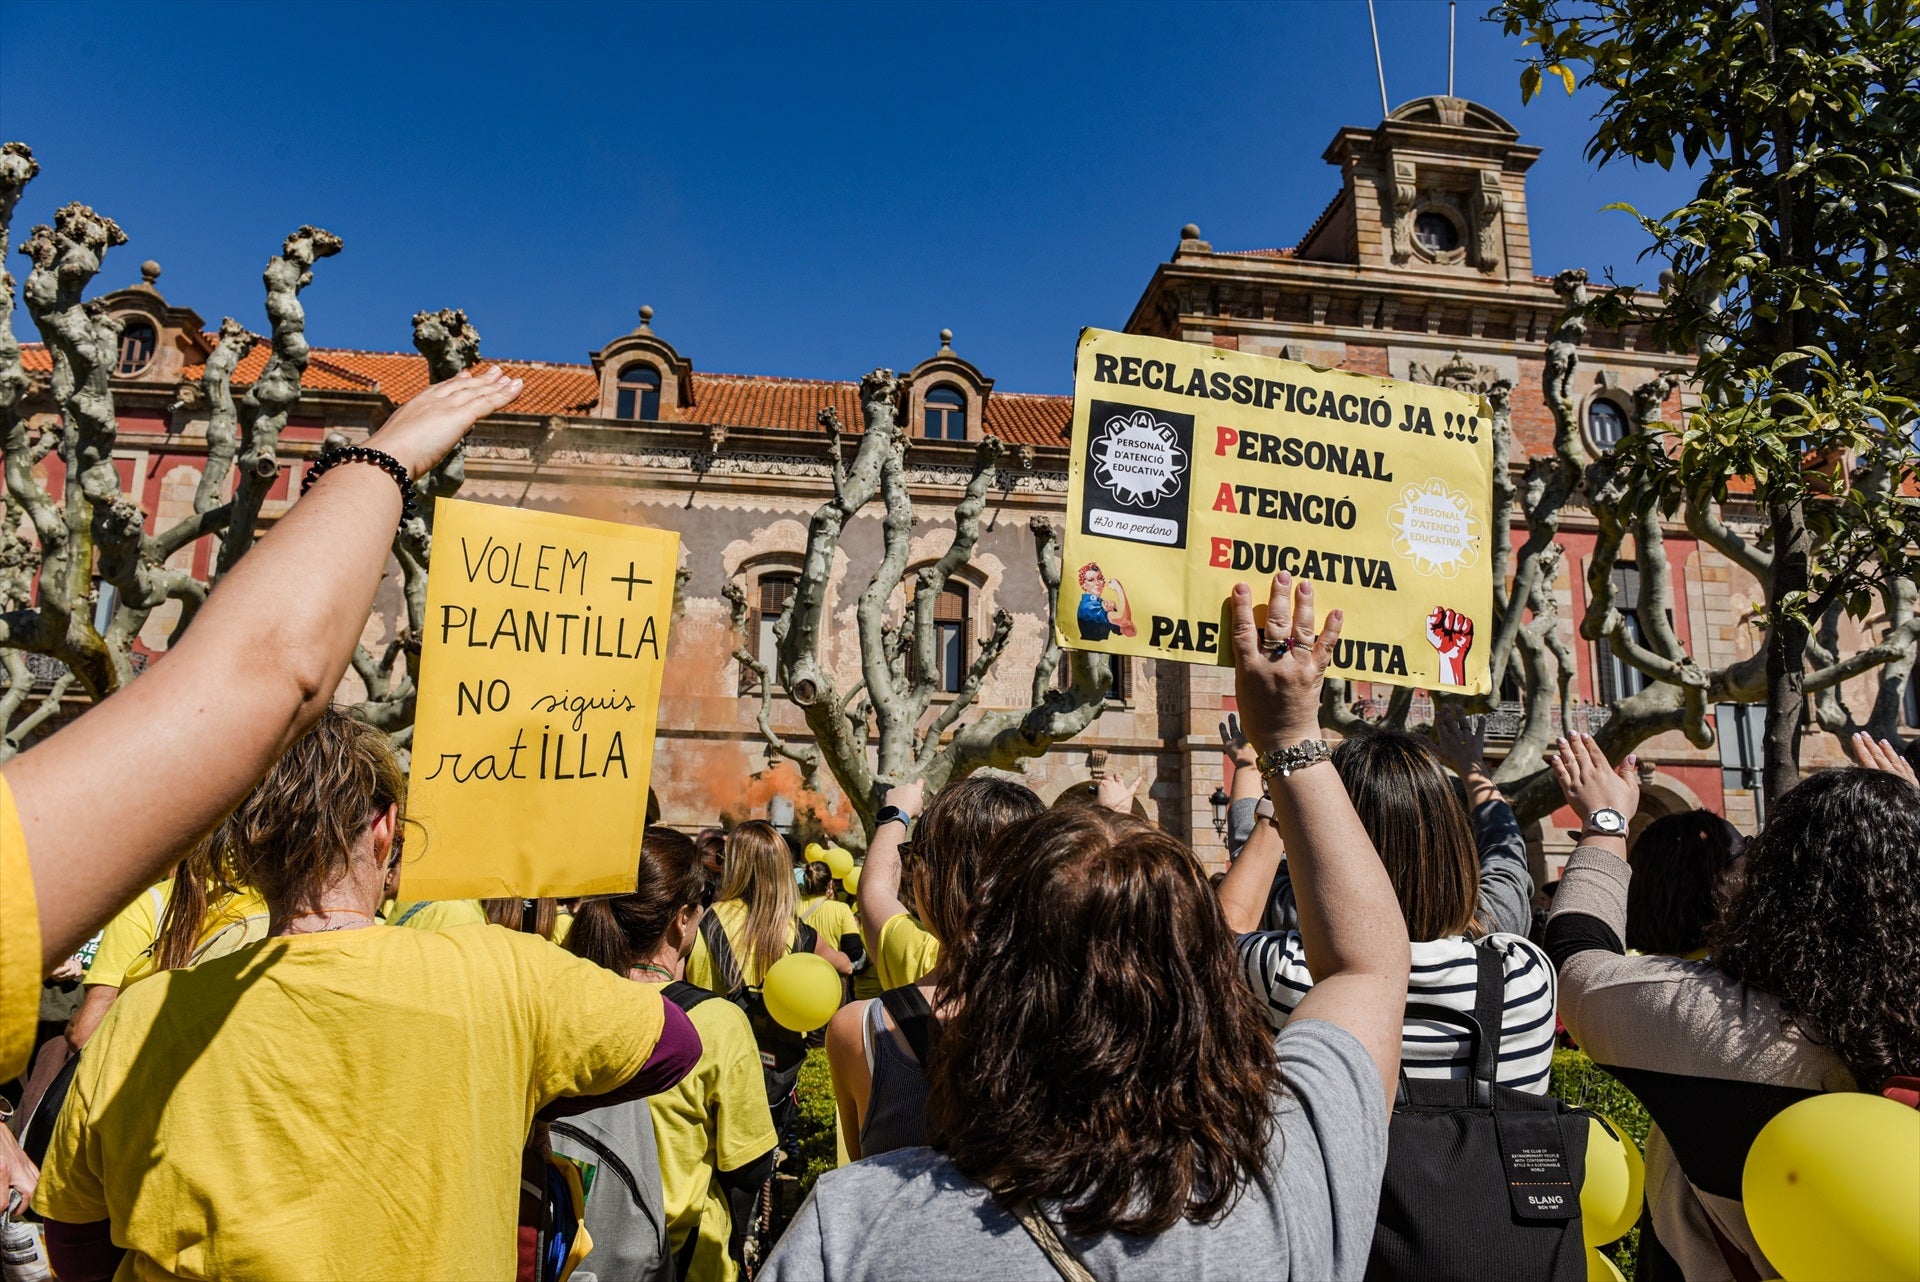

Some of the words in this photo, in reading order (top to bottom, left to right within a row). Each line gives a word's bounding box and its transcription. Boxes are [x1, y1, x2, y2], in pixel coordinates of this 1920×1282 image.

[1094, 353, 1391, 428] RECLASSIFICACIÓ
[1399, 404, 1436, 436] JA
[1117, 438, 1166, 452] PERSONAL
[1115, 450, 1164, 465] D'ATENCIÓ
[1215, 426, 1393, 482] PERSONAL
[1112, 463, 1166, 477] EDUCATIVA
[1212, 482, 1357, 529] ATENCIÓ
[1412, 506, 1460, 521] PERSONAL
[1115, 520, 1129, 530] no
[1129, 523, 1172, 537] perdono
[1411, 519, 1460, 534] D'ATENCIÓ
[1409, 532, 1462, 548] EDUCATIVA
[461, 536, 588, 595] VOLEM
[611, 561, 653, 601] +
[1209, 537, 1397, 591] EDUCATIVA
[1149, 615, 1219, 653] PAE
[457, 678, 511, 716] NO
[531, 688, 636, 732] siguis
[1528, 1195, 1564, 1204] SLANG
